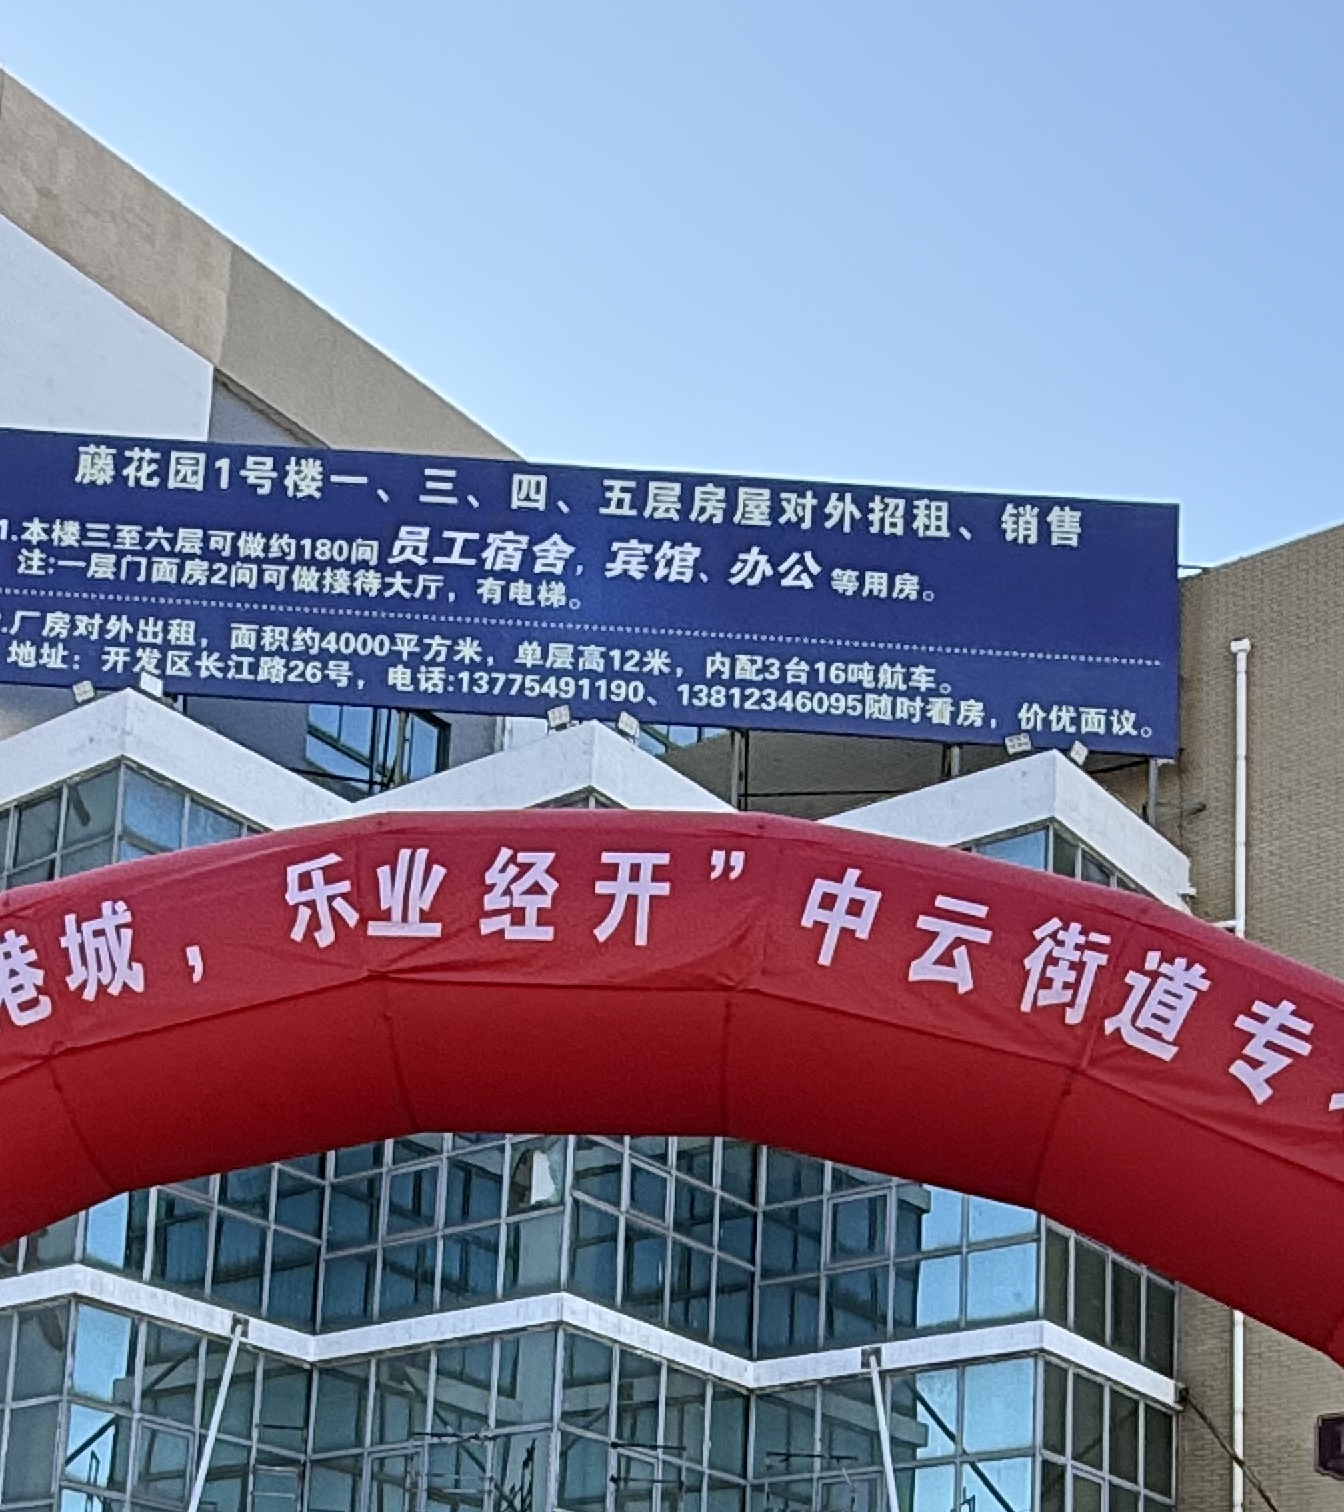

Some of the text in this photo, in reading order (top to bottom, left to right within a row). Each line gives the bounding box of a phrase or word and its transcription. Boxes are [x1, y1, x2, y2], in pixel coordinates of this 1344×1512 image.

[74, 443, 1083, 548] 藤花园1号楼一、三、四、五层房屋对外招租、销售
